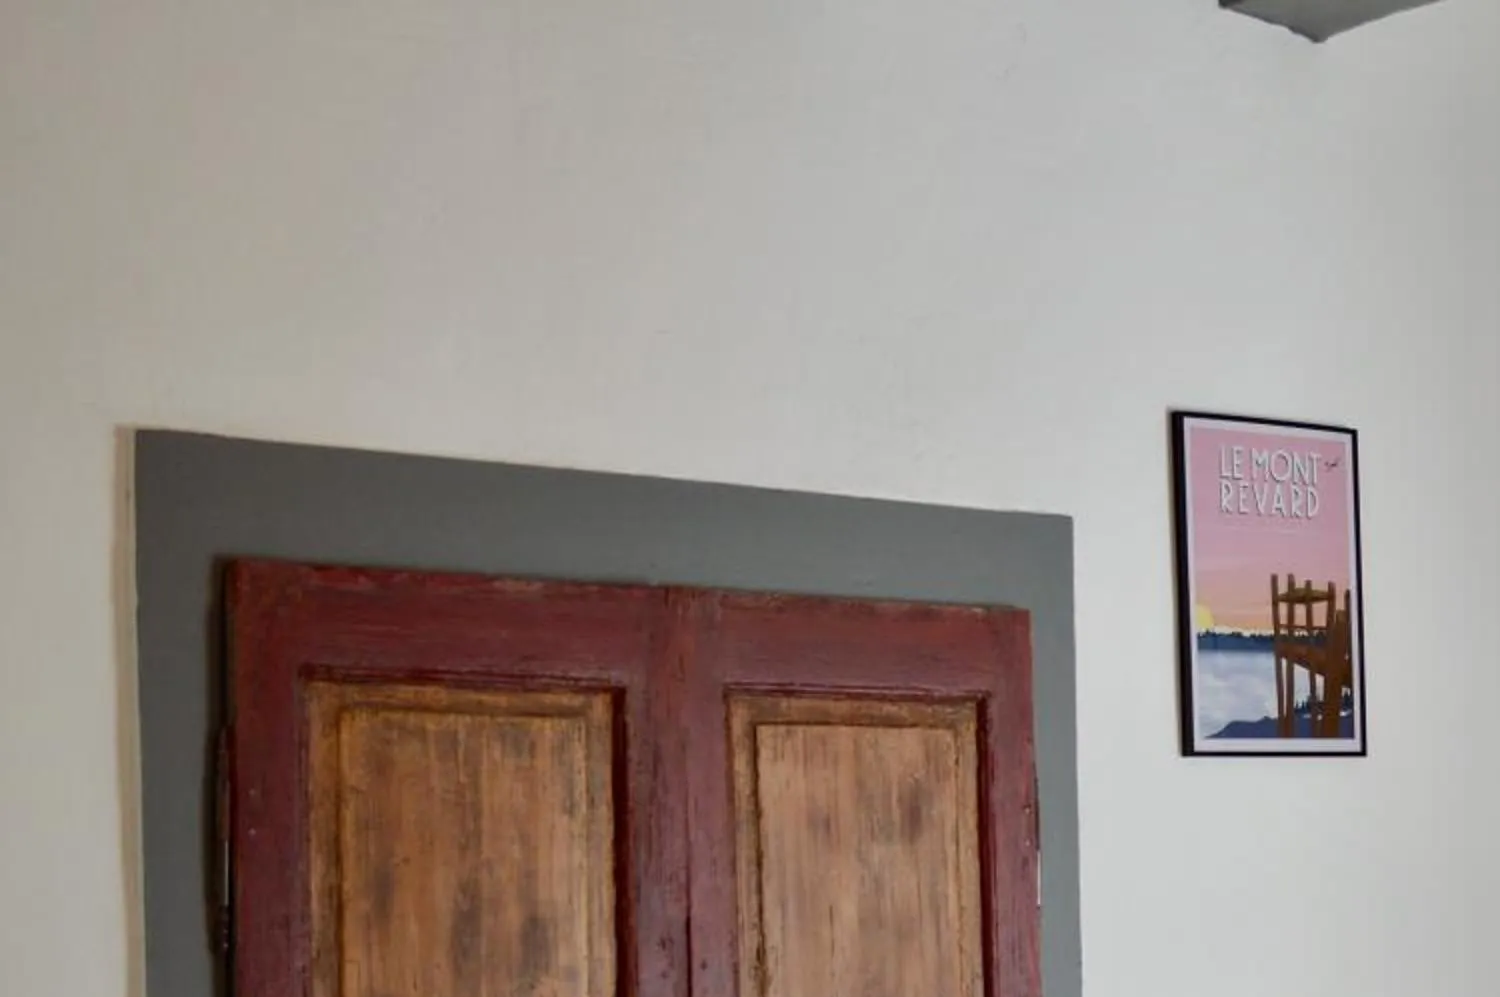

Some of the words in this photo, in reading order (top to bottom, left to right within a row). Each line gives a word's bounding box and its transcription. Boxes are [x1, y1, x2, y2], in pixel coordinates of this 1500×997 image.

[1219, 445, 1244, 480] LE
[1250, 447, 1322, 486] MONT
[1220, 480, 1320, 520] REVARD
